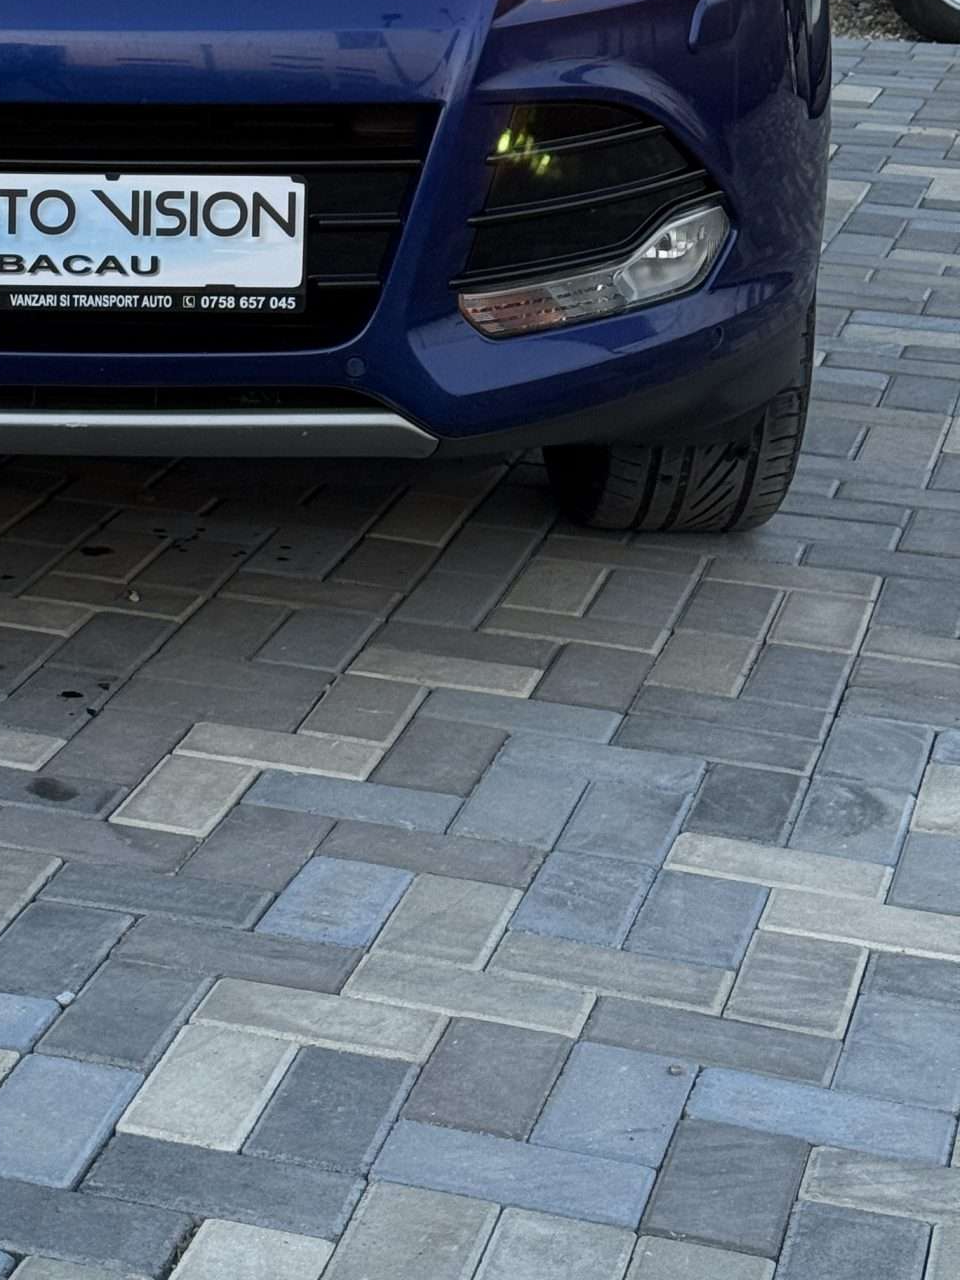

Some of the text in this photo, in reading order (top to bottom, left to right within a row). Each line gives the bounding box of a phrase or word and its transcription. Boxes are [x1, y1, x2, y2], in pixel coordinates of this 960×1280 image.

[91, 188, 297, 238] VISION
[9, 293, 57, 307] VANZARI
[59, 294, 71, 307] SI
[72, 294, 140, 308] TRANSPORT
[141, 295, 173, 308] AUTO
[200, 296, 236, 309] 0758
[239, 296, 266, 309] 657
[269, 296, 296, 310] 045
